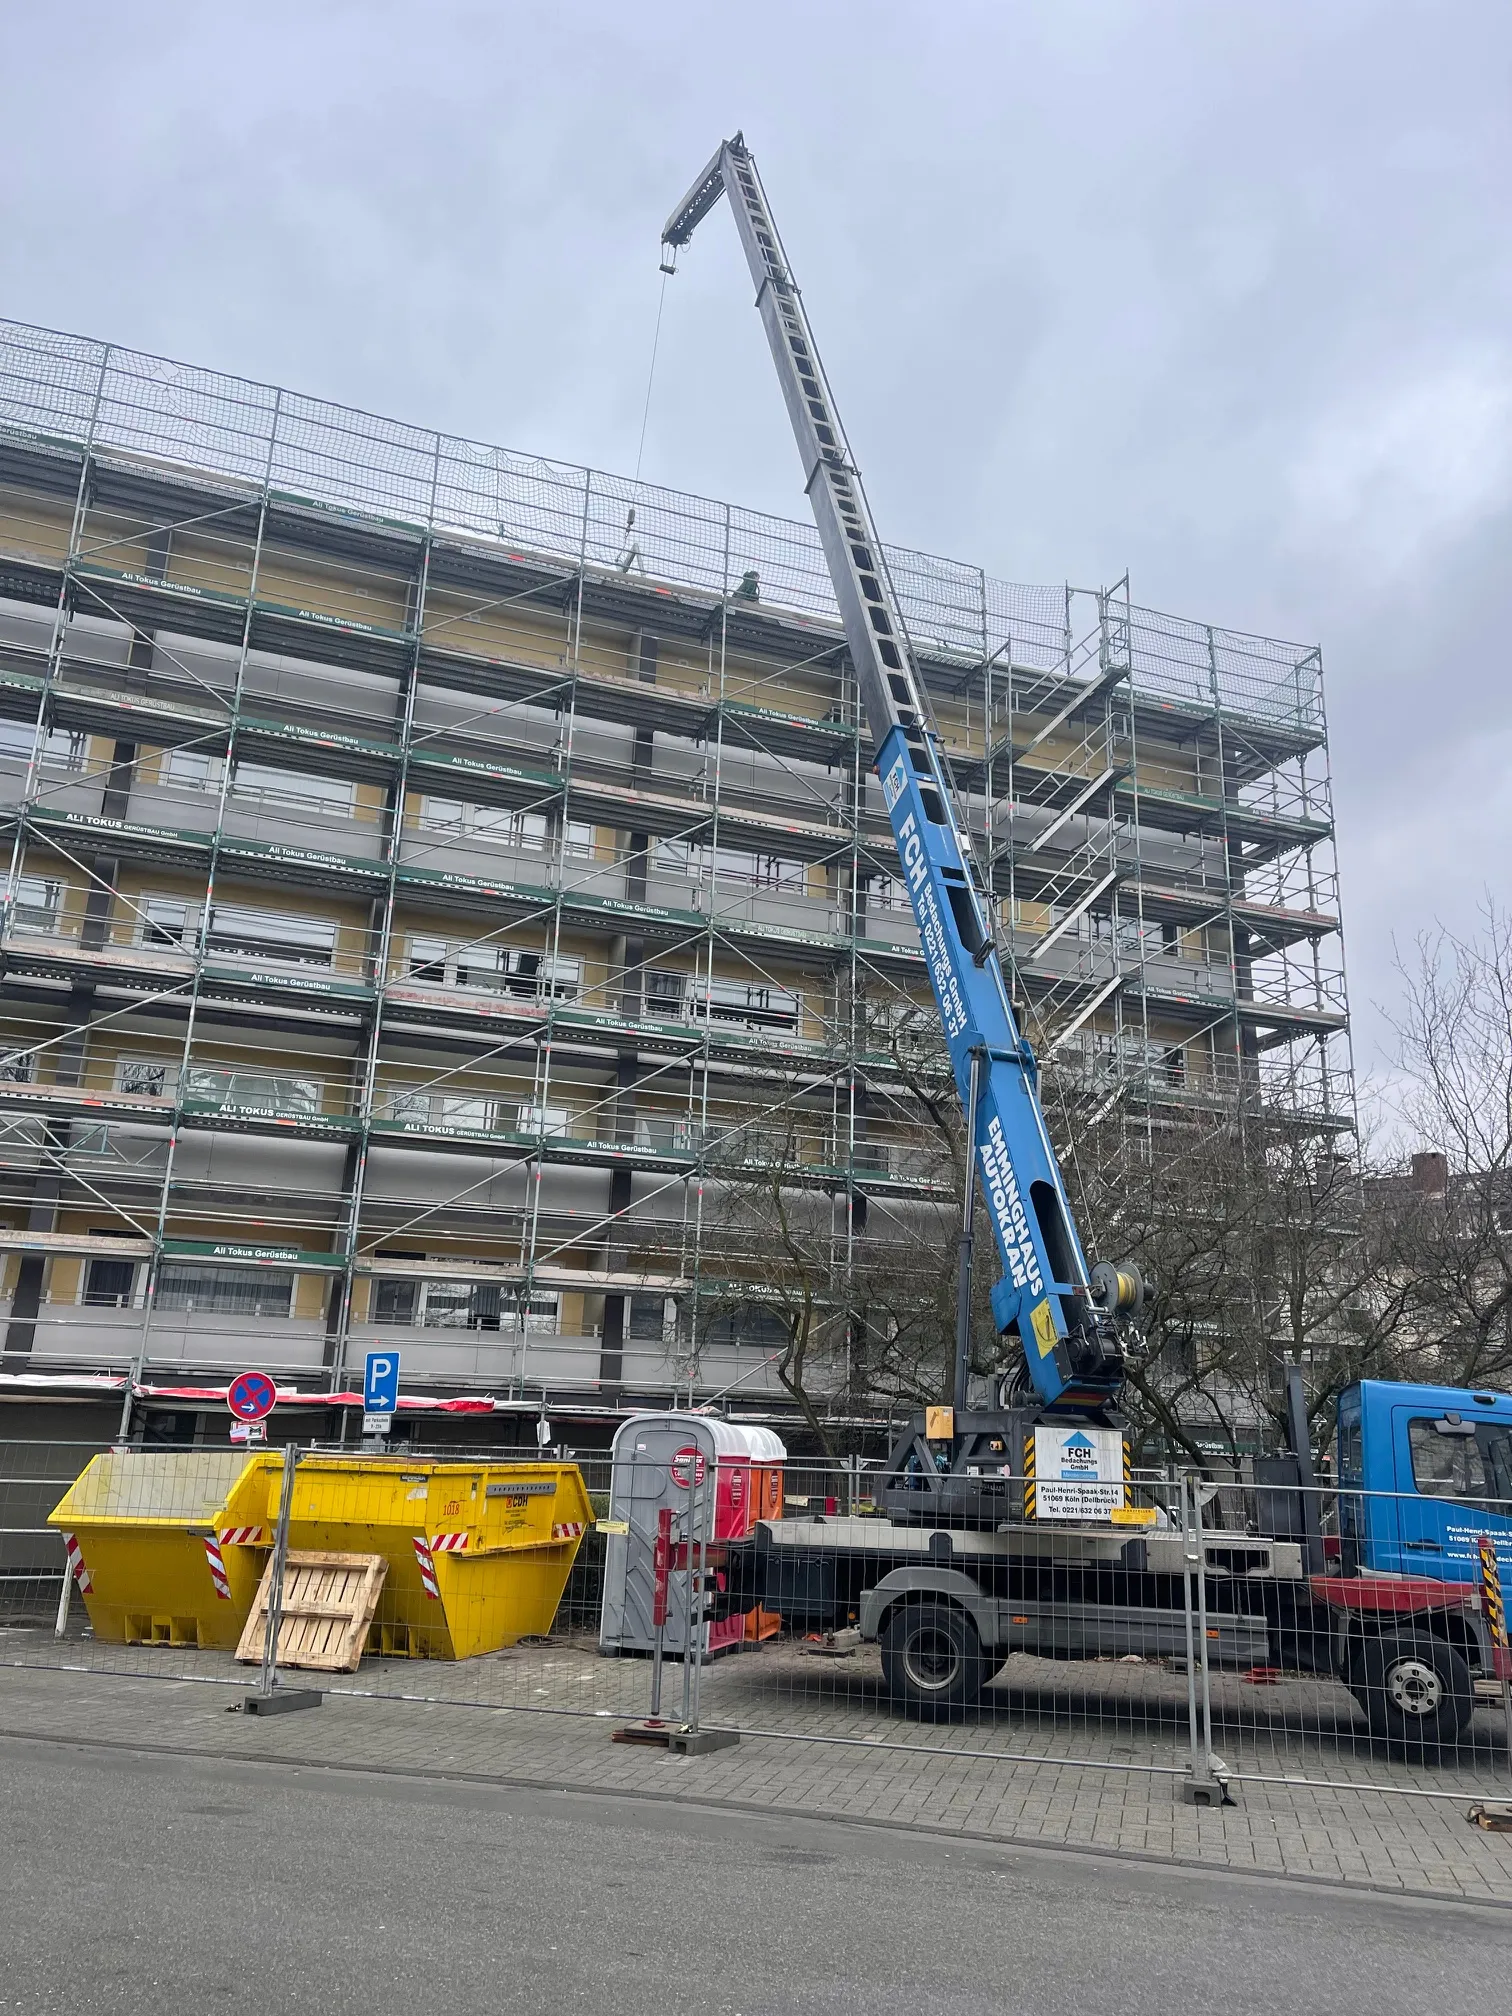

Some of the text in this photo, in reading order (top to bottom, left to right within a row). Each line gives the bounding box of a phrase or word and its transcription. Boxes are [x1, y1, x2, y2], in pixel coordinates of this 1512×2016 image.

[0, 427, 37, 440] erüstbau
[312, 501, 384, 523] Ali Tokus Gerüstbau
[122, 572, 201, 594] Ali Tokus Gerüstbau
[299, 610, 372, 631] Ali Tokus Gerüstbau
[296, 727, 318, 737] Tokus
[320, 731, 358, 745] Gerüstbau
[464, 760, 484, 769] Tokus
[486, 764, 522, 776] Gerüstbau
[66, 813, 83, 822] ALI
[86, 816, 122, 828] TOKUS
[269, 846, 346, 864] Ali Tokus Gerüstbau
[898, 812, 928, 893] FCH
[455, 876, 475, 886] Tokus
[477, 880, 514, 891] Gerüstbau
[613, 902, 633, 911] Tokus
[635, 904, 668, 916] Gerüstbau
[924, 882, 967, 1030] Bedachungs GmbH
[917, 894, 959, 1038] Tel. 0221/632 06 37
[265, 976, 288, 985] Tokus
[290, 978, 330, 990] Gerüstbau
[606, 1019, 626, 1027] Tokus
[628, 1022, 663, 1032] Gerüstbau
[219, 1104, 236, 1113] ALI
[239, 1106, 274, 1116] TOKUS
[404, 1123, 420, 1131] ALI
[423, 1125, 455, 1135] TOKUS
[599, 1142, 619, 1150] Tokus
[621, 1144, 657, 1154] Gerüstbau
[988, 1116, 1043, 1296] EMMINGHAUS
[980, 1144, 1027, 1288] AUTOKRAN
[214, 1246, 297, 1260] Ali Tokus Gerüstbau
[370, 1358, 391, 1393] P
[1068, 1448, 1091, 1458] FCH
[1061, 1457, 1098, 1465] Bedachungs
[1065, 1495, 1080, 1503] Köln
[443, 1504, 459, 1515] 1018
